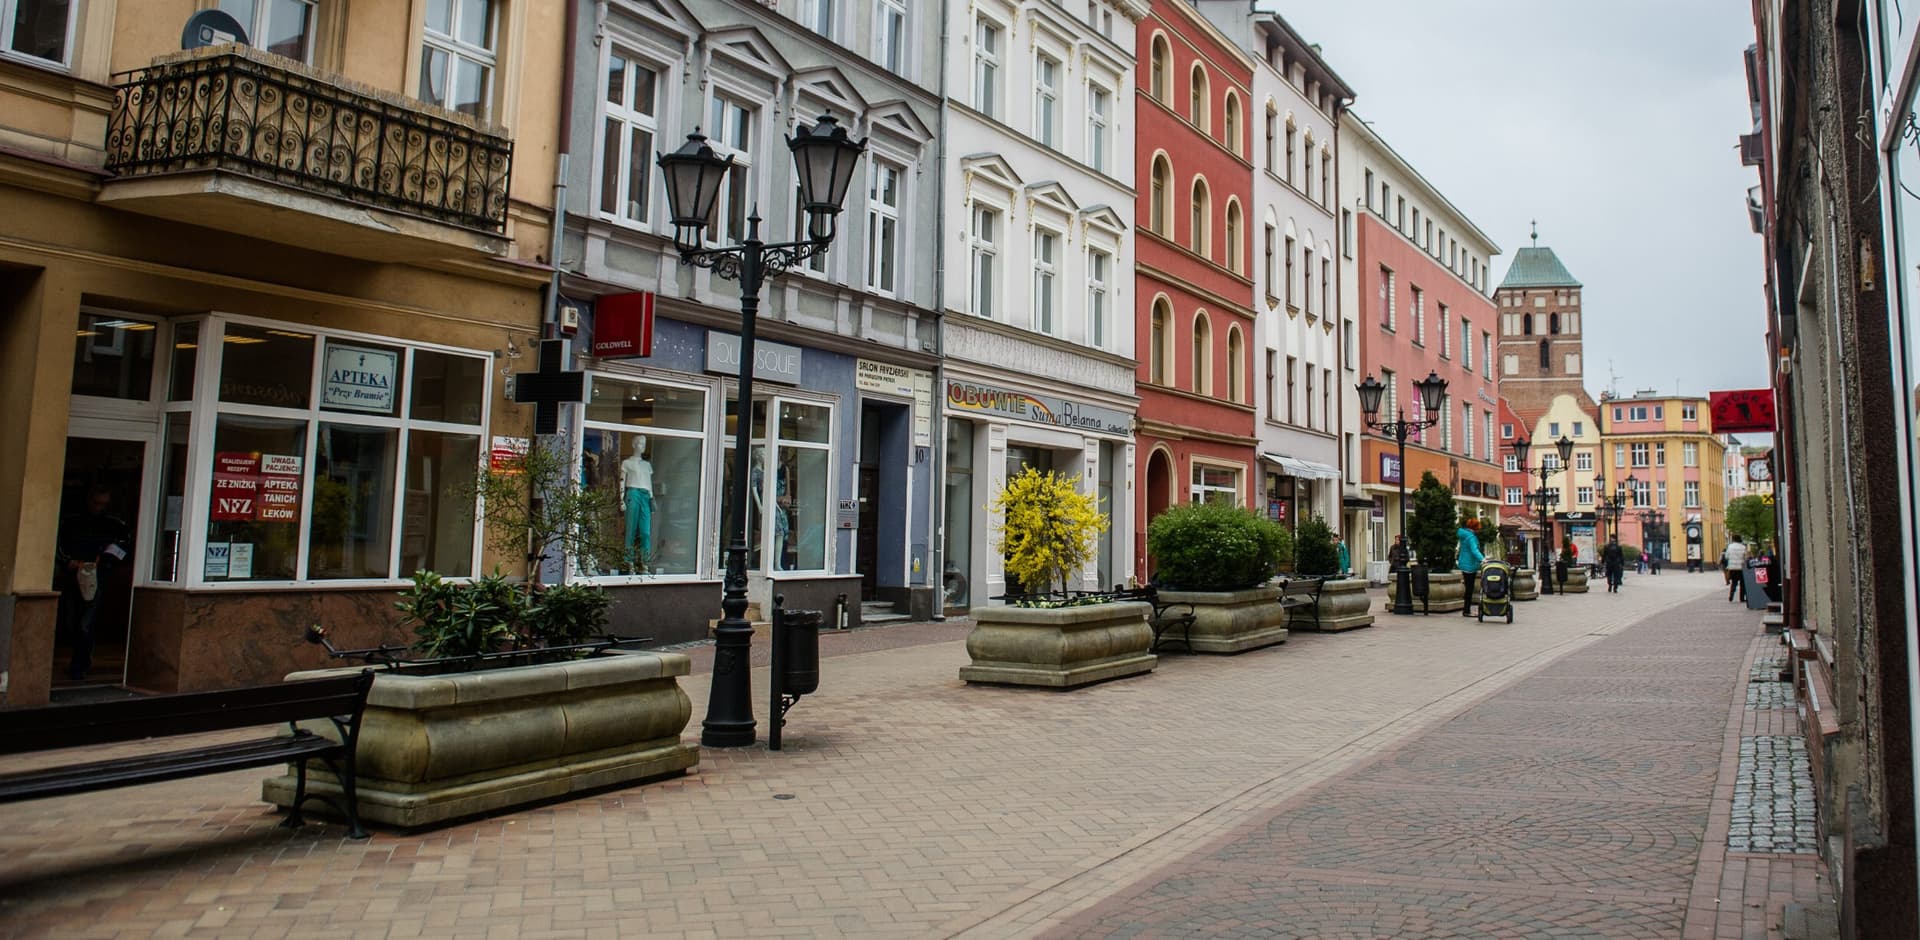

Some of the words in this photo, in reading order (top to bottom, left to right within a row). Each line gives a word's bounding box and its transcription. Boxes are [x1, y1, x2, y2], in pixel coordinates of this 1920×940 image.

[716, 342, 797, 375] QUSQUE
[858, 361, 879, 373] SALON
[331, 369, 388, 386] APTEKA
[951, 382, 1026, 415] OBUWIE
[1064, 402, 1102, 428] Belanna
[271, 457, 296, 465] UWAGA
[915, 449, 924, 463] 10
[216, 479, 227, 488] ZE
[228, 478, 257, 492] ZNIŻKĄ
[263, 480, 298, 490] APTEKA
[264, 493, 296, 503] TANICH
[218, 498, 252, 514] NFZ
[262, 508, 294, 519] LEKÓW
